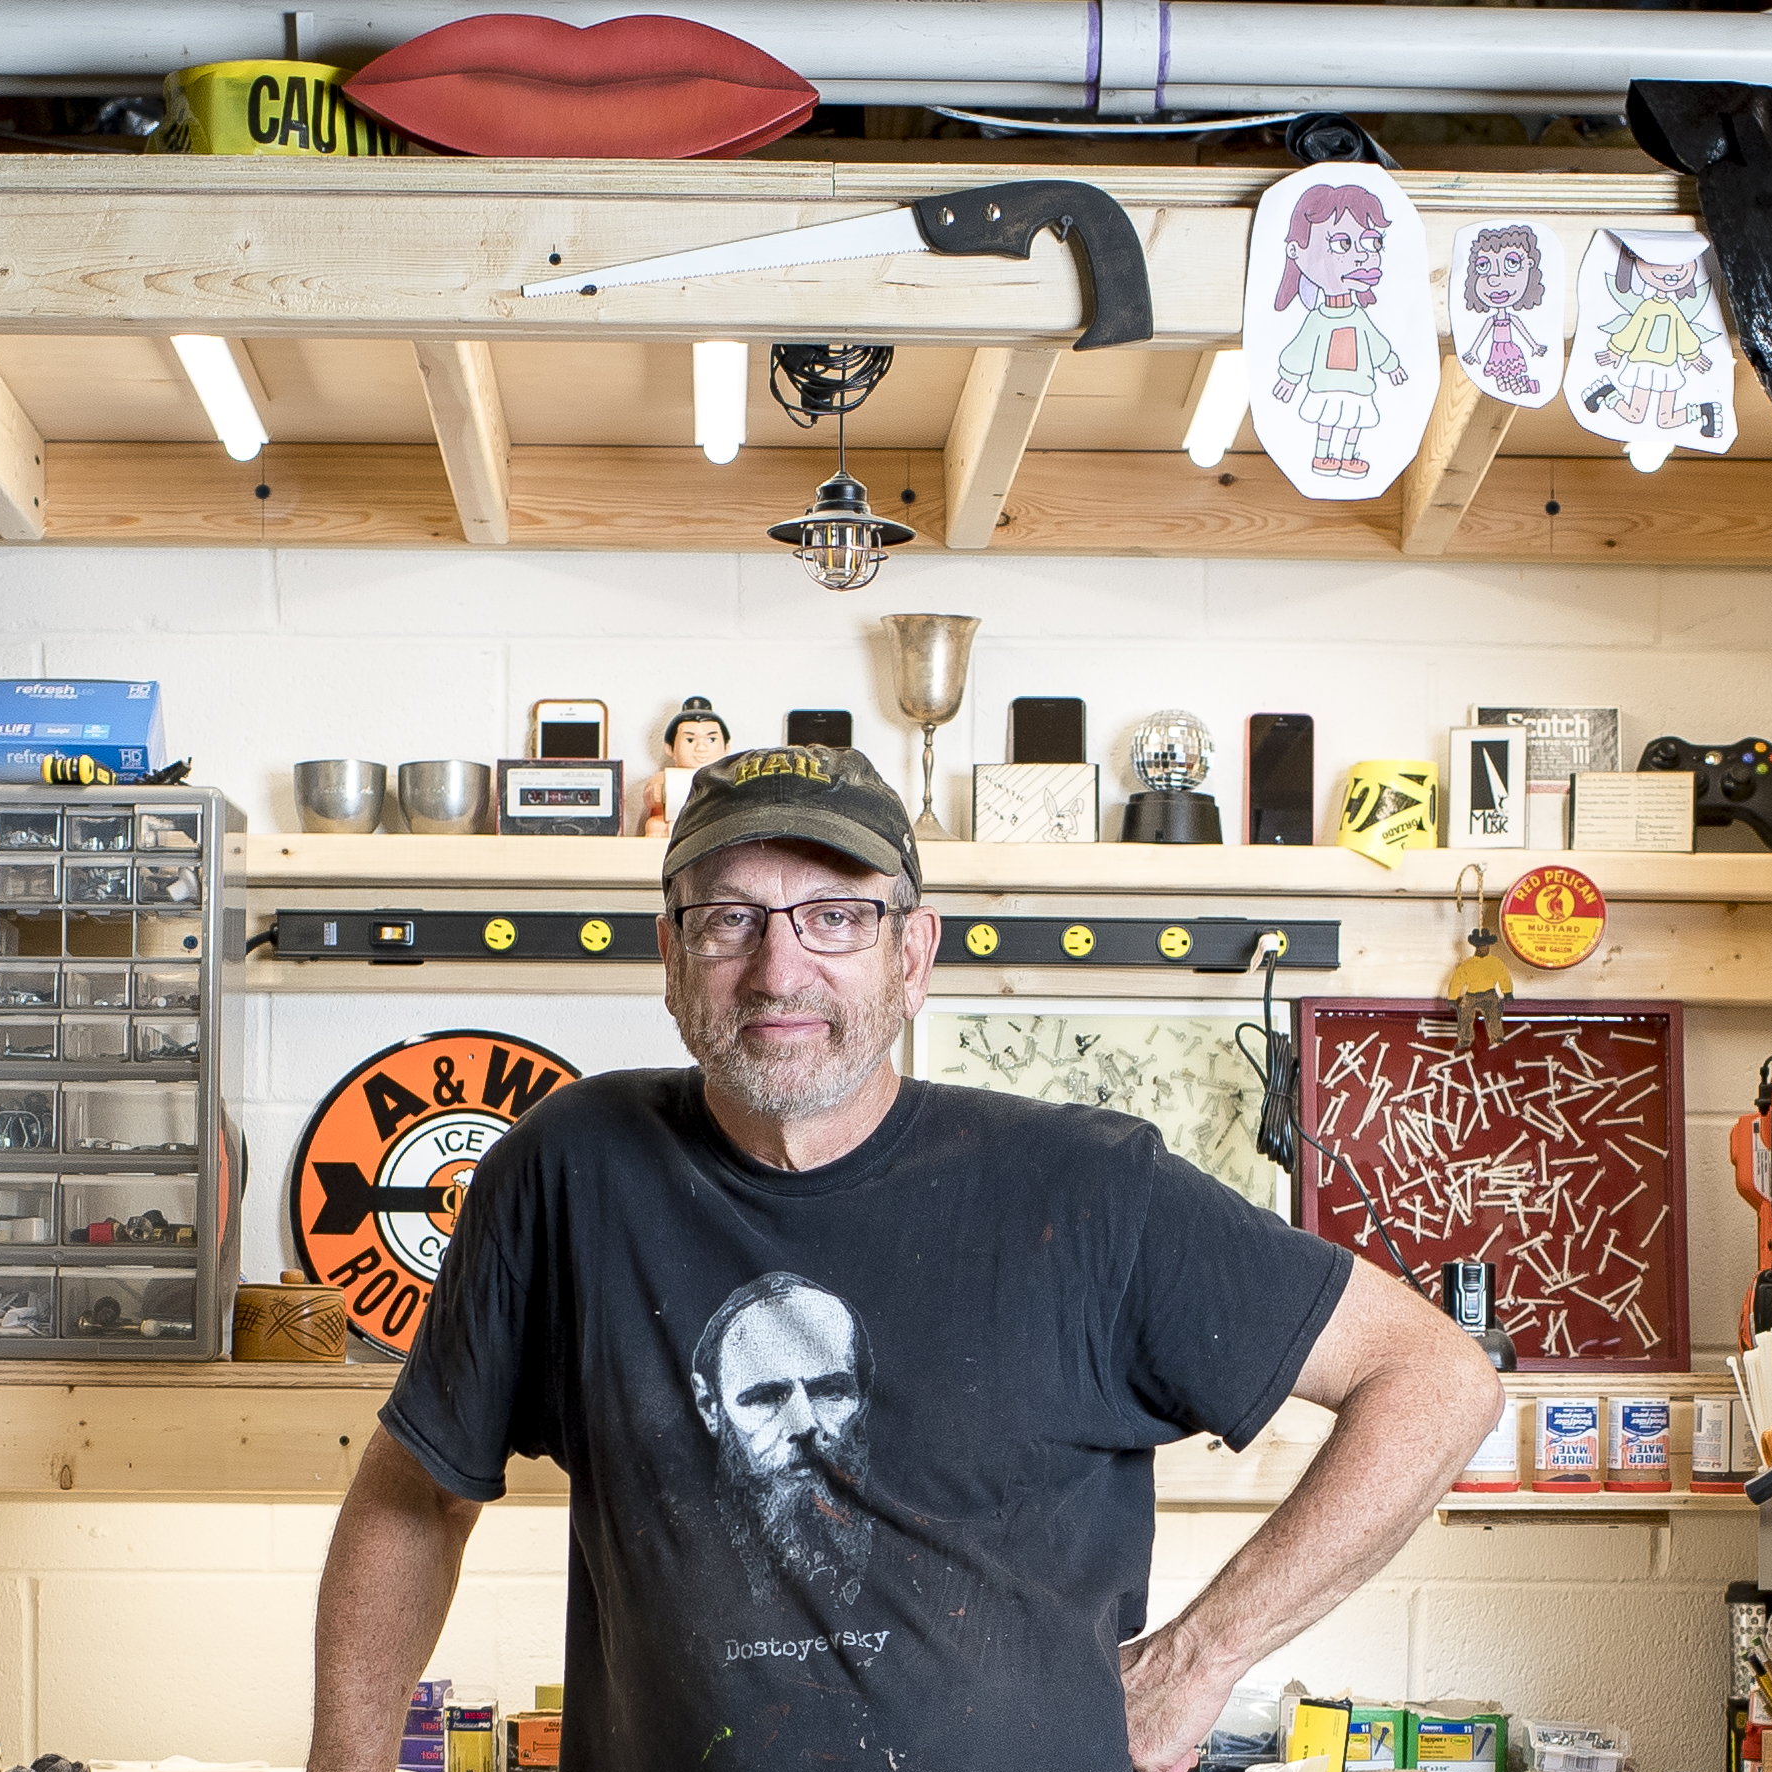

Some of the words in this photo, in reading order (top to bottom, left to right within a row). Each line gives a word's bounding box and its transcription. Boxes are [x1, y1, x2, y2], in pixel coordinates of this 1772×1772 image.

[15, 683, 75, 695] refresh
[734, 752, 831, 786] HAIL
[1514, 875, 1541, 901] RED
[1544, 870, 1598, 905] PELICAN
[1528, 924, 1580, 933] MUSTARD
[434, 1129, 485, 1157] ICE
[327, 1245, 430, 1338] ROO
[1558, 1444, 1589, 1455] MATE
[1636, 1444, 1664, 1455] MATE
[1552, 1454, 1593, 1465] TIMBER
[1628, 1453, 1667, 1464] TIMBER
[725, 1630, 890, 1661] Dostoyevsky
[1361, 1724, 1369, 1732] 11
[1464, 1725, 1472, 1733] 11
